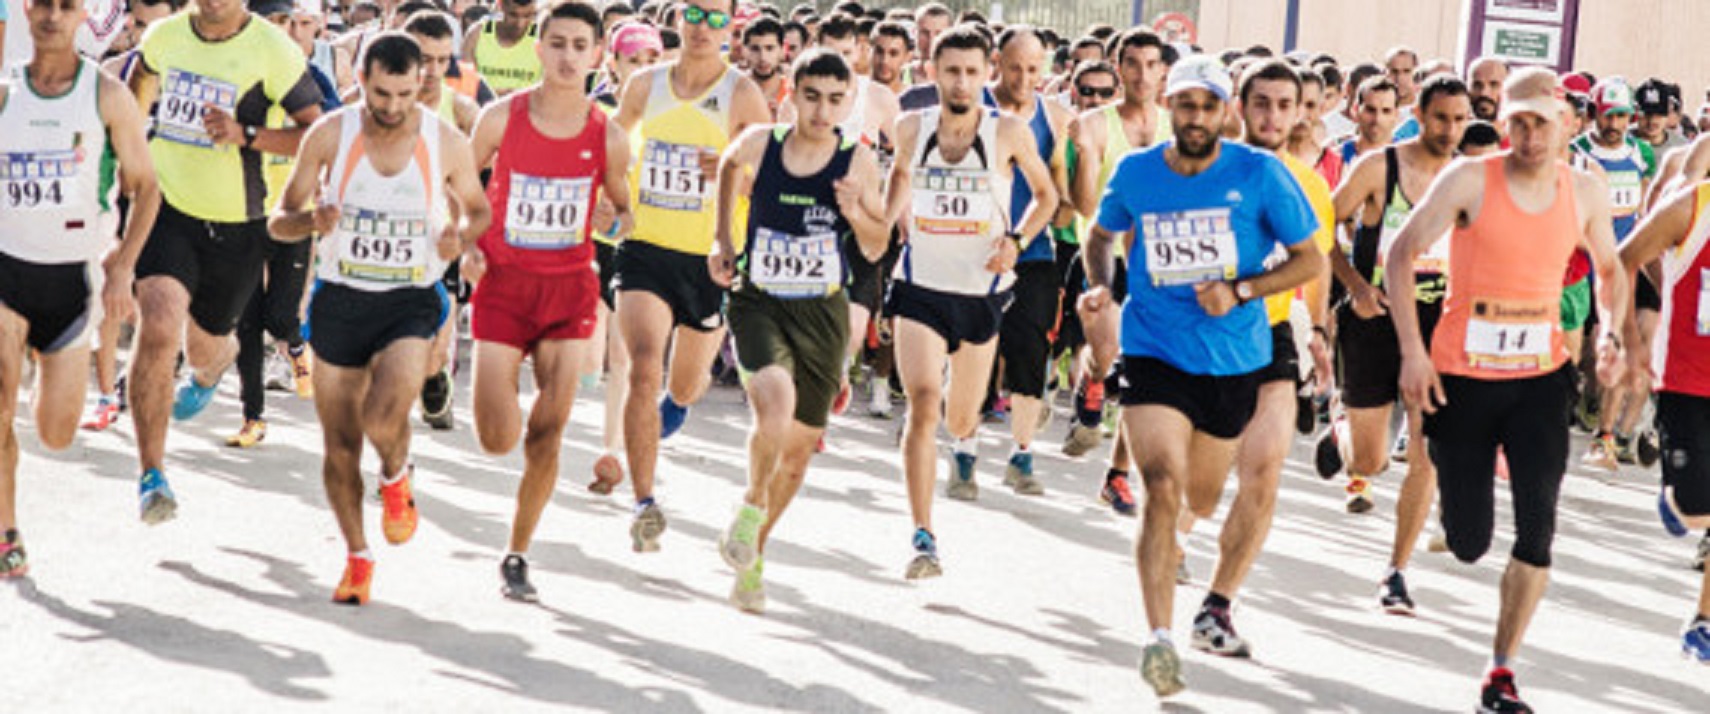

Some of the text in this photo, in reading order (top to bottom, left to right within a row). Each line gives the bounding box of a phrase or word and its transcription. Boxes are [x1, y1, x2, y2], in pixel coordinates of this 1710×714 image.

[648, 166, 706, 194] 1151
[8, 180, 63, 207] 994
[933, 194, 969, 217] 50
[516, 202, 577, 228] 940
[351, 236, 413, 263] 695
[1154, 236, 1219, 267] 988
[762, 254, 824, 278] 992
[1497, 328, 1528, 351] 14
